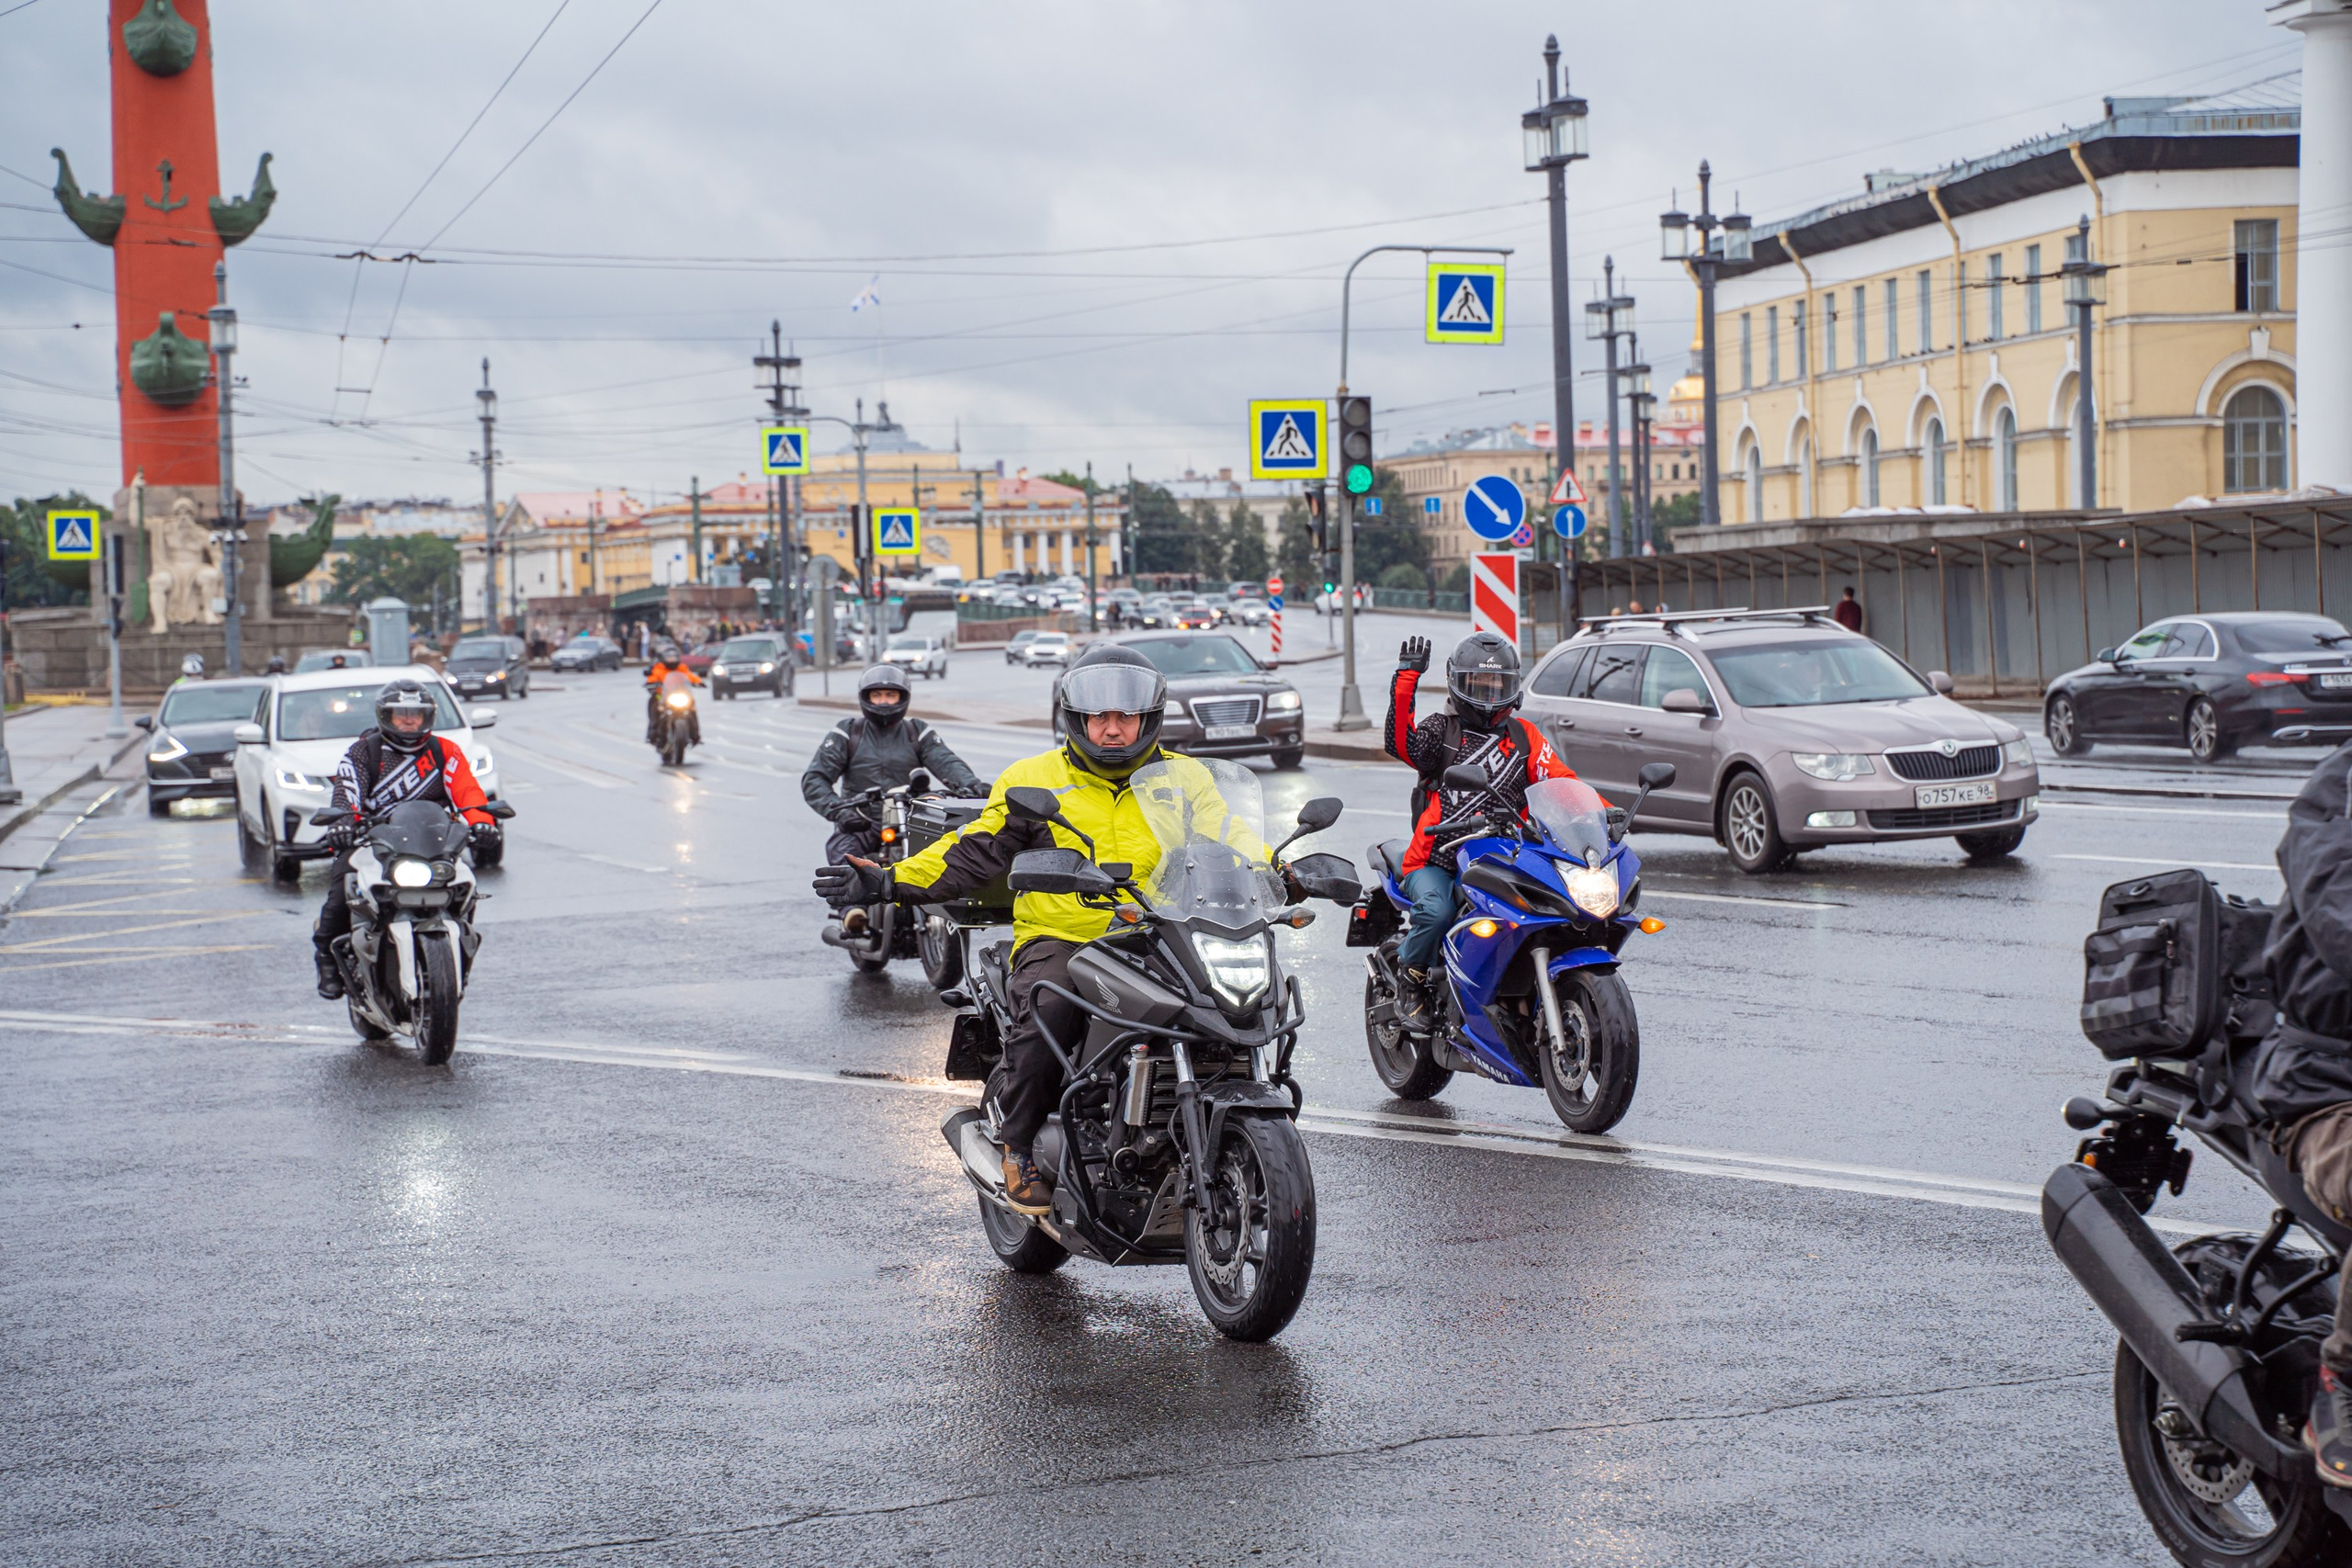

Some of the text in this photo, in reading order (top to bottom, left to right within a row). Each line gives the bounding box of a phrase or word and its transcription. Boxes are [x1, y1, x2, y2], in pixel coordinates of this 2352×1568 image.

[1976, 784, 1989, 795] 98
[1098, 1001, 1123, 1014] HONDA
[1470, 1052, 1510, 1084] YAMAHA
